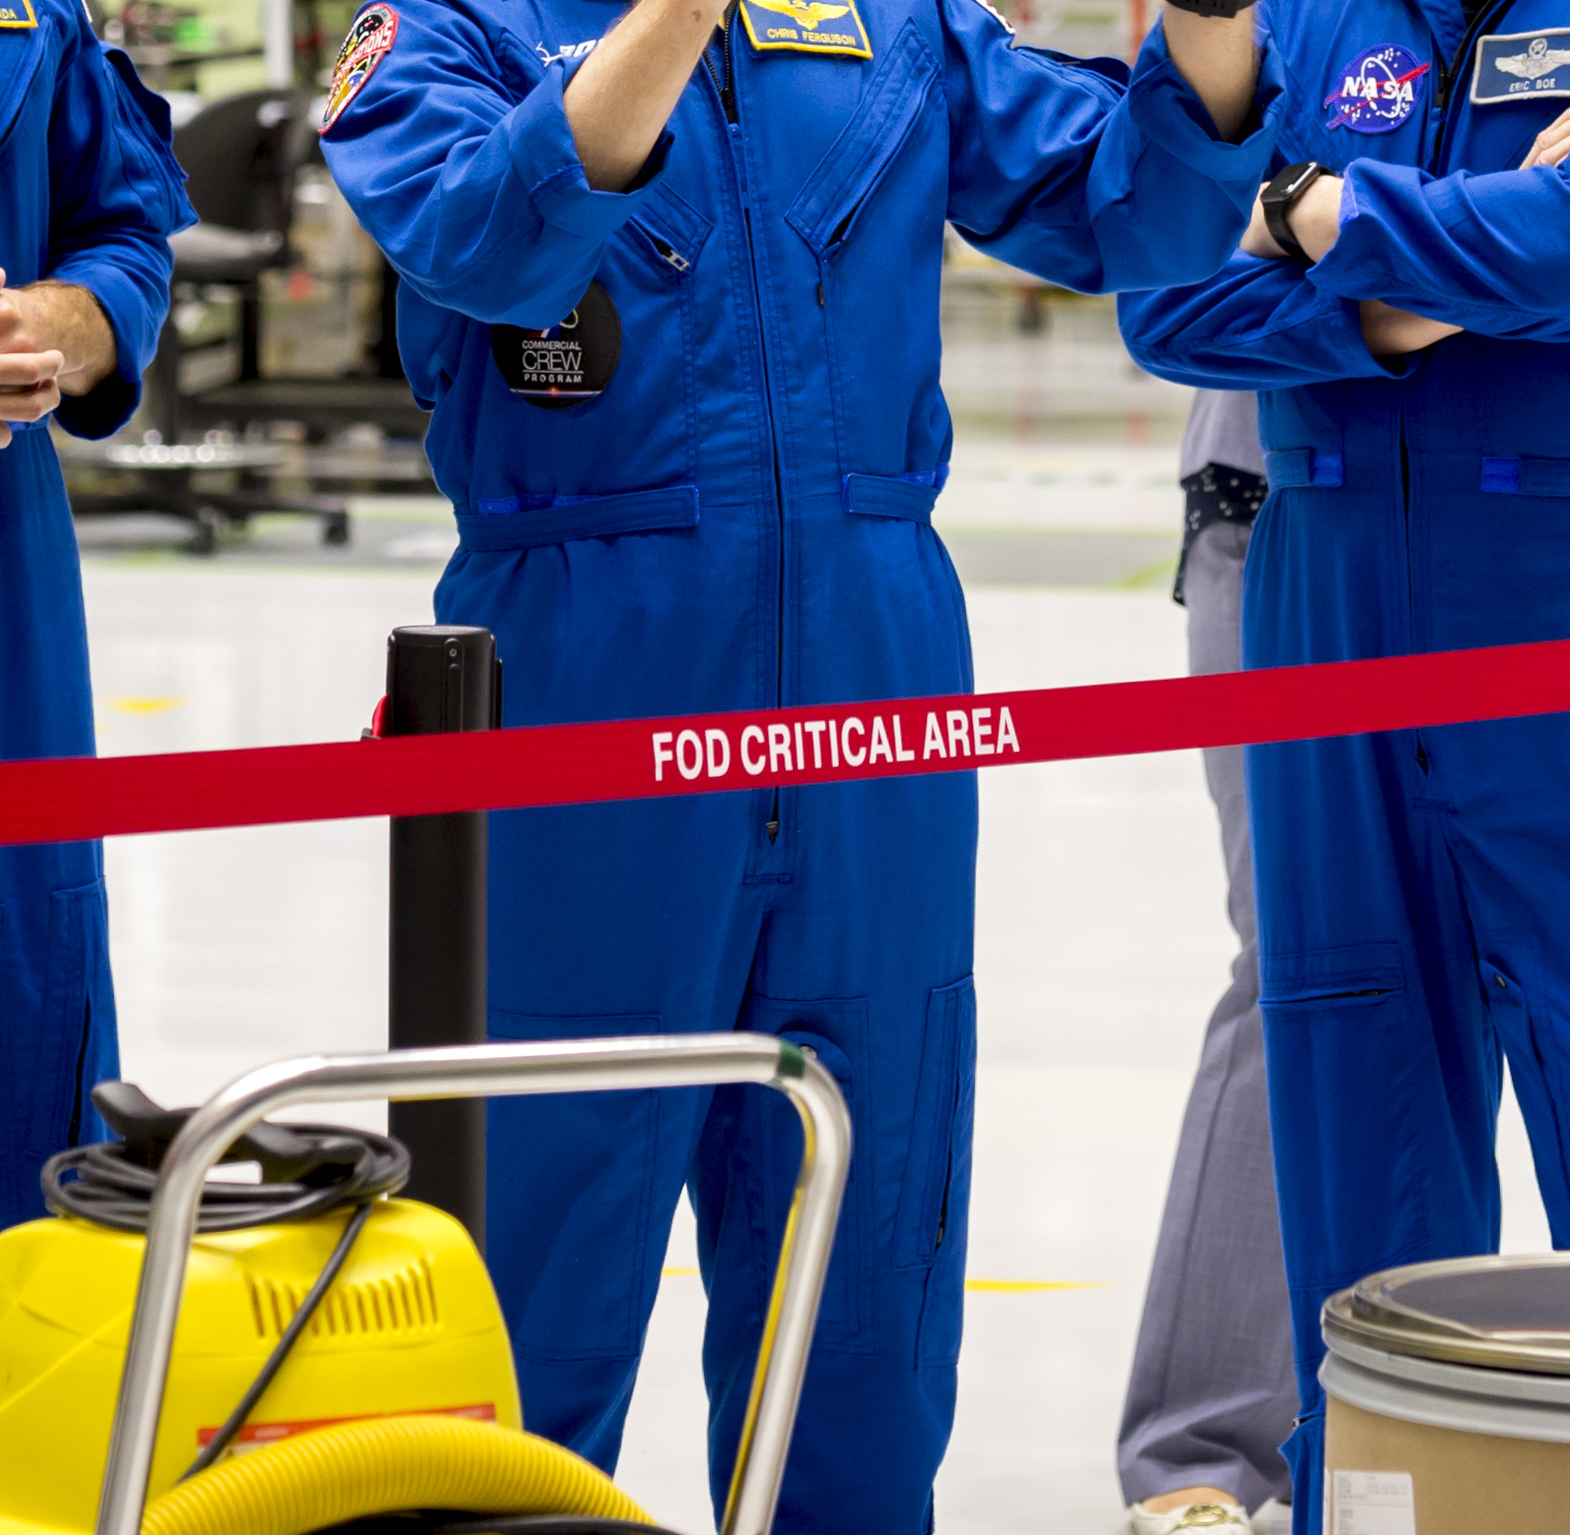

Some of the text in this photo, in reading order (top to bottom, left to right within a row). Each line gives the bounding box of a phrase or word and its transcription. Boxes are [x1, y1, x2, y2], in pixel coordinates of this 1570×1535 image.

[767, 28, 856, 46] CHRIS FERGUSON
[1342, 76, 1414, 102] NASA
[1509, 78, 1556, 93] ERIC BOE
[522, 340, 582, 351] COMMERCIAL
[522, 350, 582, 371] CREW
[524, 373, 582, 383] PROGRAM
[652, 706, 1020, 782] FOD CRITICAL AREA
